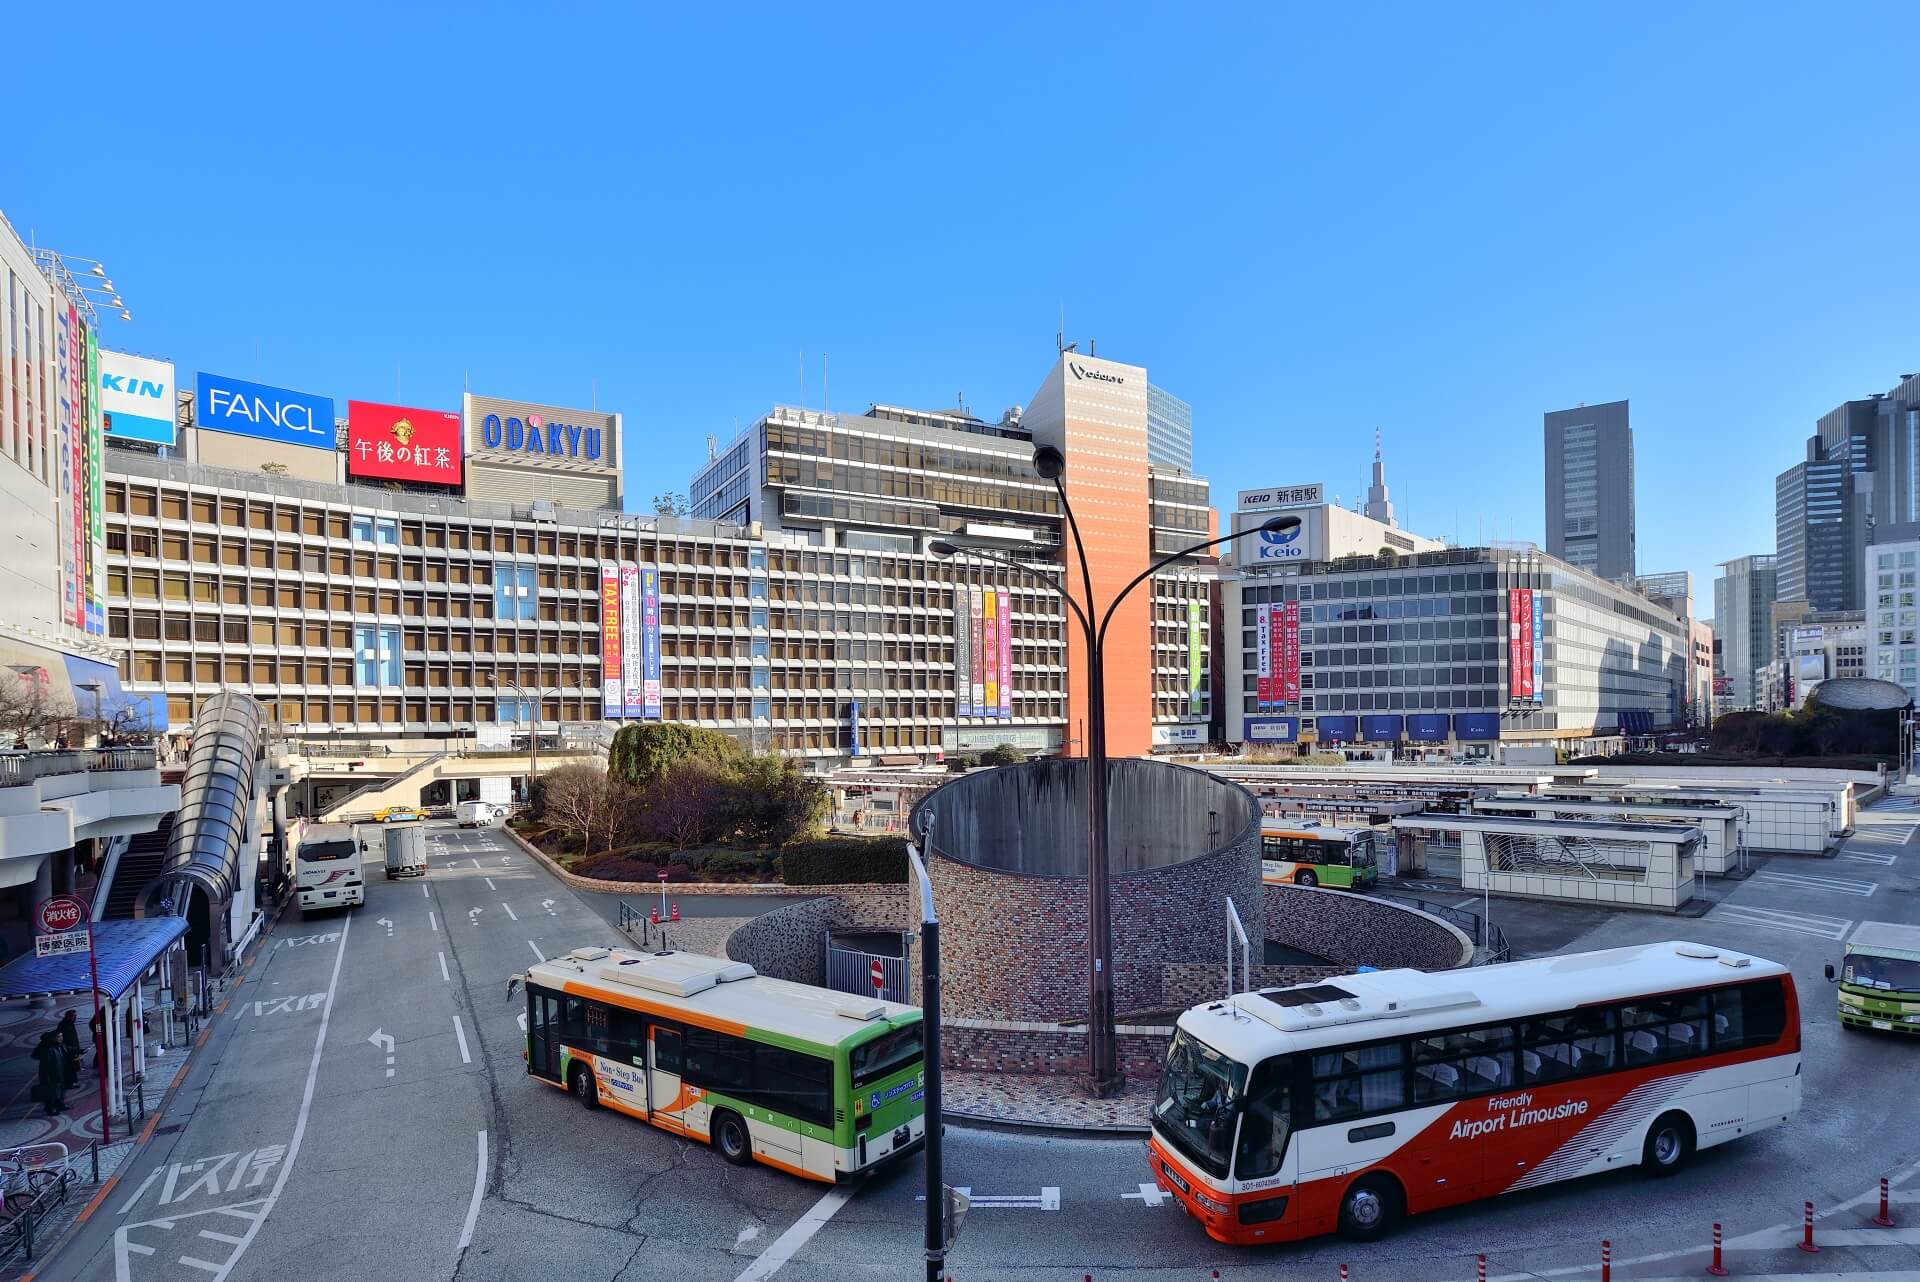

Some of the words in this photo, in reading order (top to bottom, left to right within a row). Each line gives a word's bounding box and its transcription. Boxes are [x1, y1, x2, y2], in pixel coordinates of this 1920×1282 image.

[209, 389, 326, 435] FANCL
[354, 437, 450, 469] 午後の紅茶
[484, 413, 601, 461] ODAKYU
[1243, 494, 1271, 504] KEIO
[1276, 487, 1317, 503] 新宿駅
[1260, 544, 1302, 558] Keio
[604, 581, 617, 606] TAX
[605, 607, 618, 641] FREE
[46, 907, 79, 922] 消火栓
[1488, 1092, 1533, 1111] Friendly
[1449, 1116, 1506, 1140] Airport
[1509, 1099, 1588, 1128] Limousine
[117, 1144, 287, 1215] バス停
